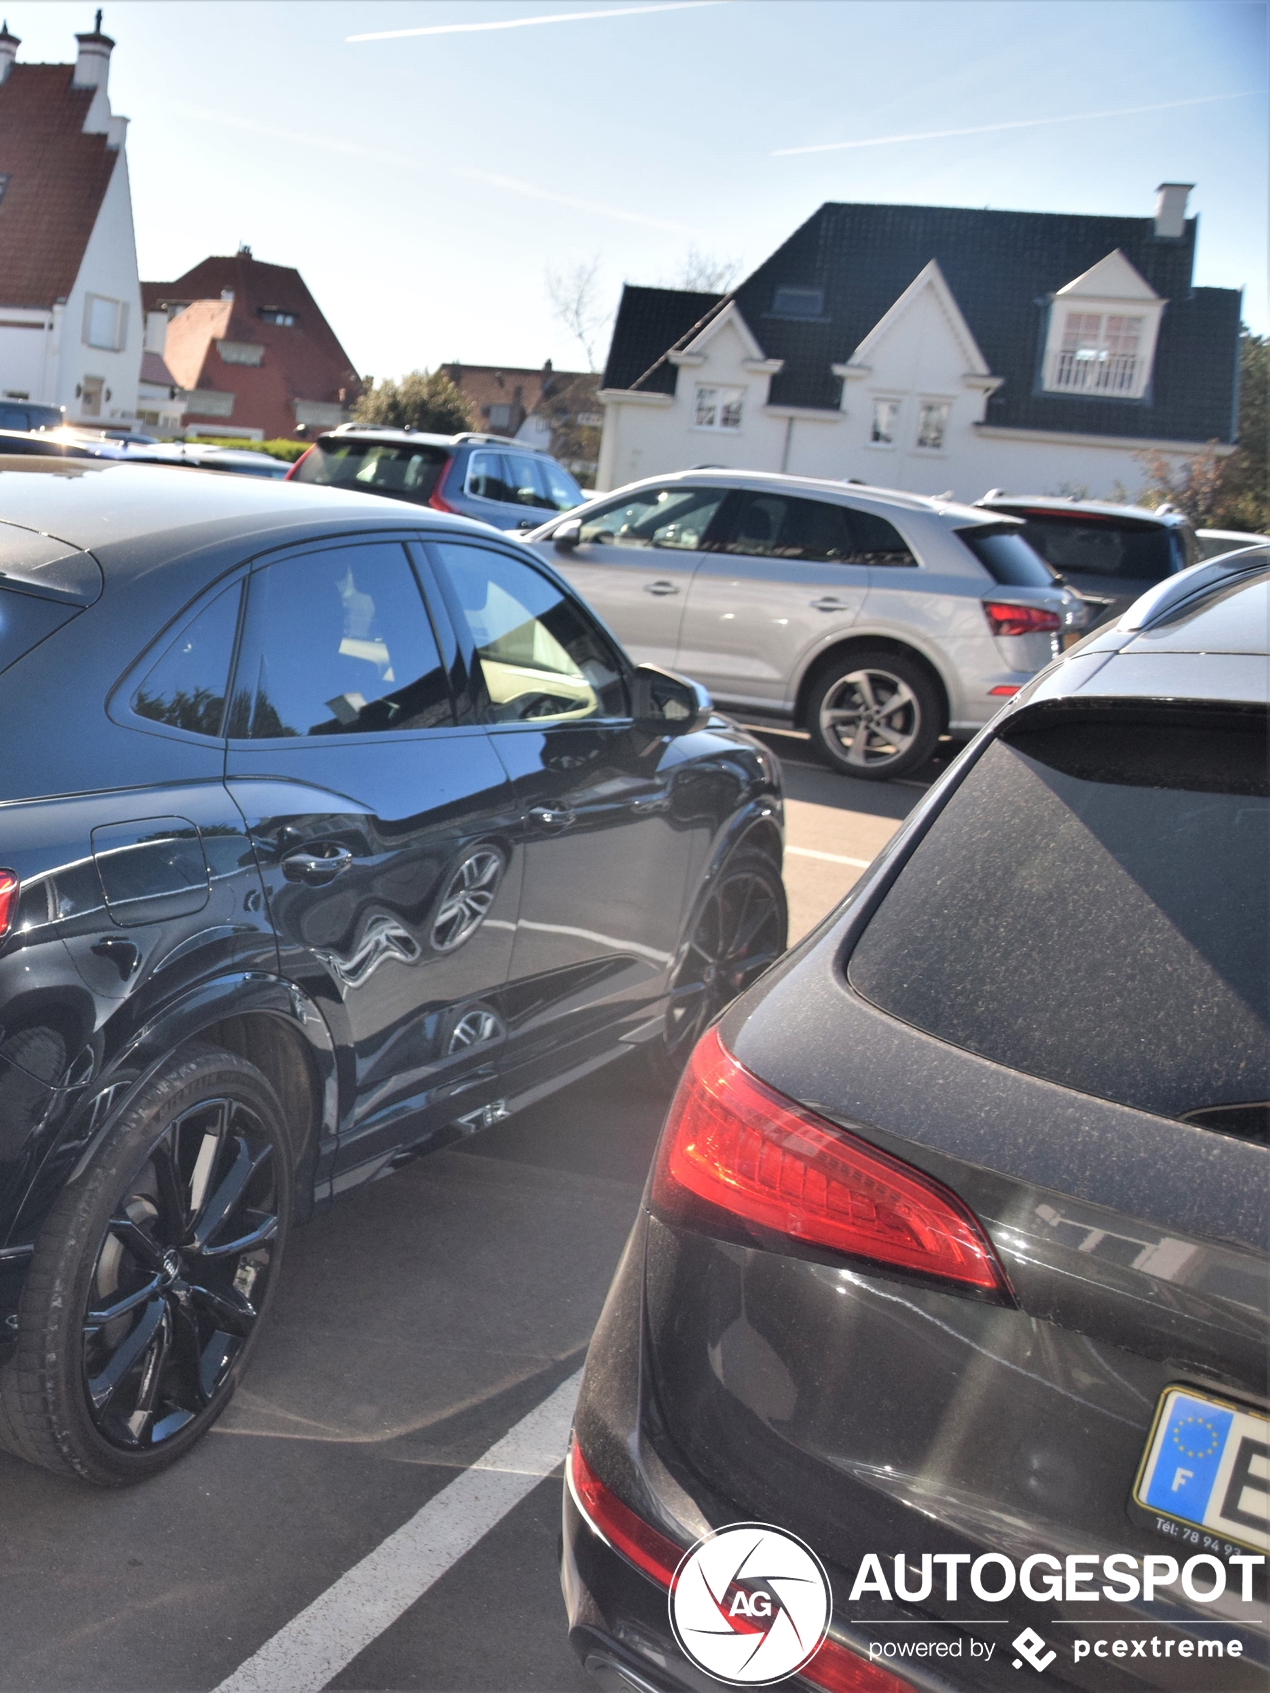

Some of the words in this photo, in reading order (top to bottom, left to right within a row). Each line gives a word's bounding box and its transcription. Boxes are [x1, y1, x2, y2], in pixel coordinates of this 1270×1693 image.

[1171, 1466, 1194, 1492] F
[1156, 1517, 1179, 1536] Tél:
[1183, 1528, 1200, 1543] 78
[1203, 1536, 1219, 1552] 94
